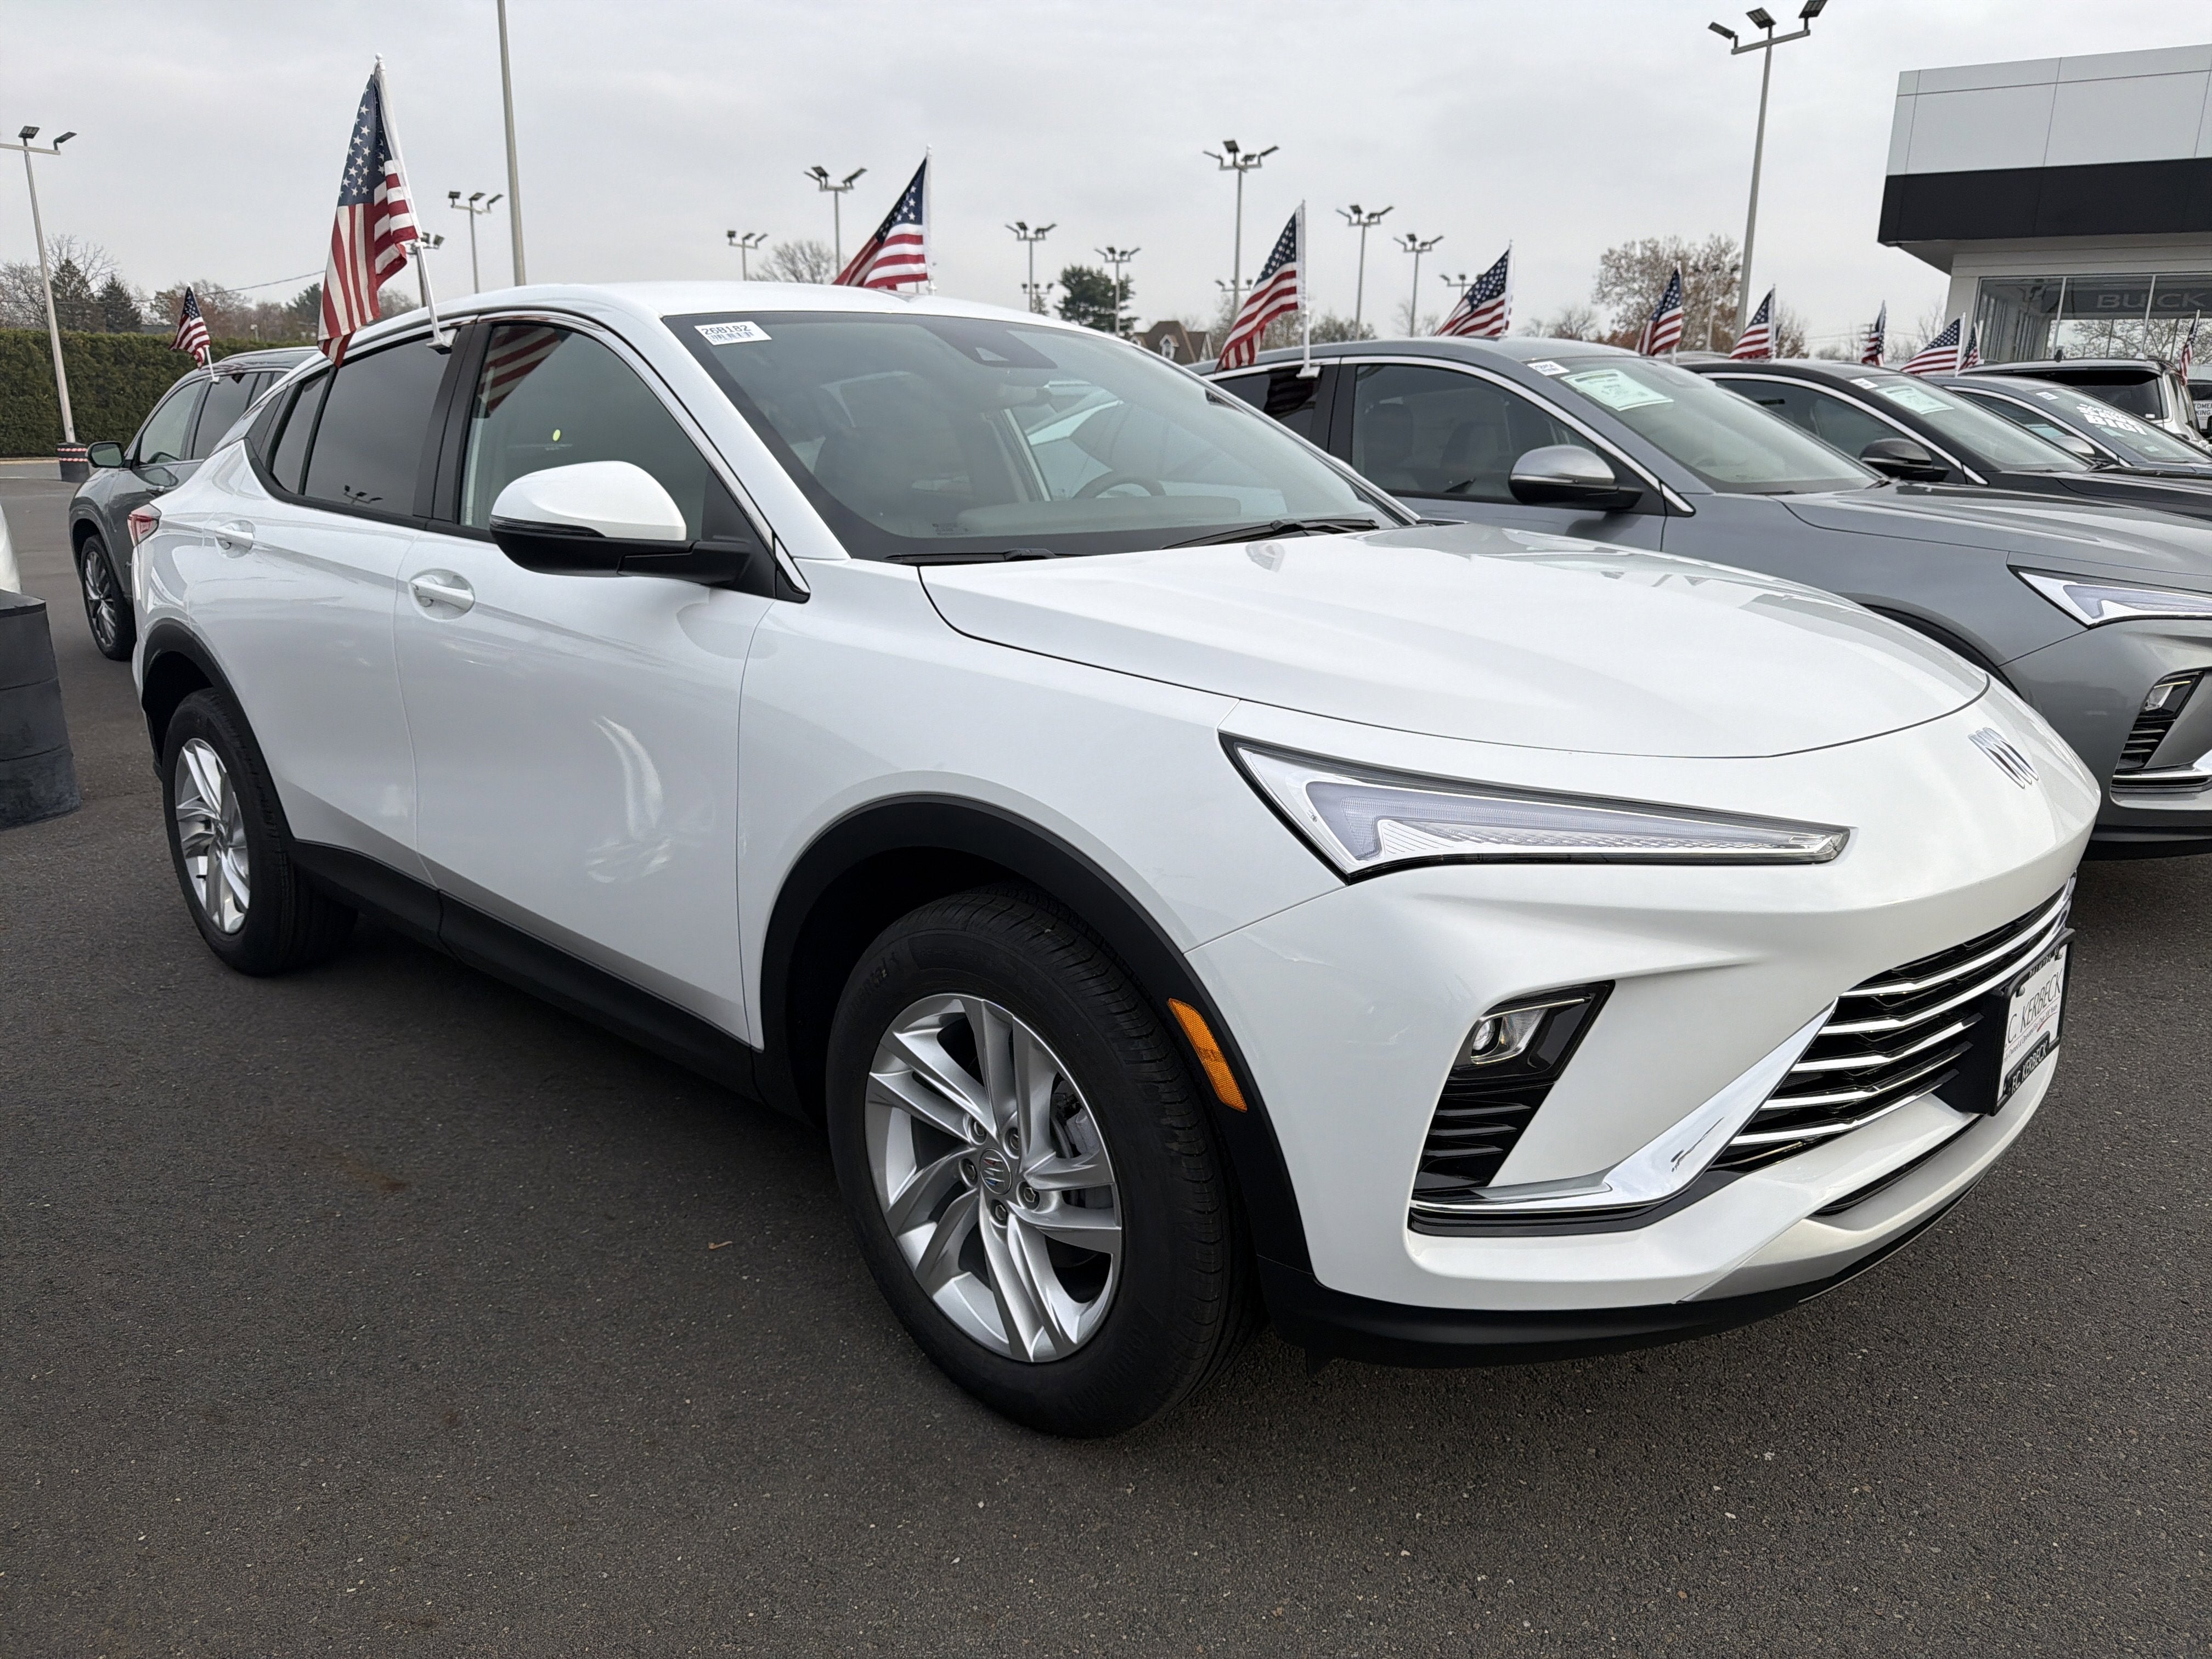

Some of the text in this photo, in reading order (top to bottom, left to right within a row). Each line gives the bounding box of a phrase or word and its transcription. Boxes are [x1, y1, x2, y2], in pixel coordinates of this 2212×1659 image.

[2097, 292, 2207, 308] BUCK
[702, 325, 751, 335] 26B182
[2020, 967, 2063, 1033] KERBECK
[2022, 1040, 2048, 1082] KERBECK
